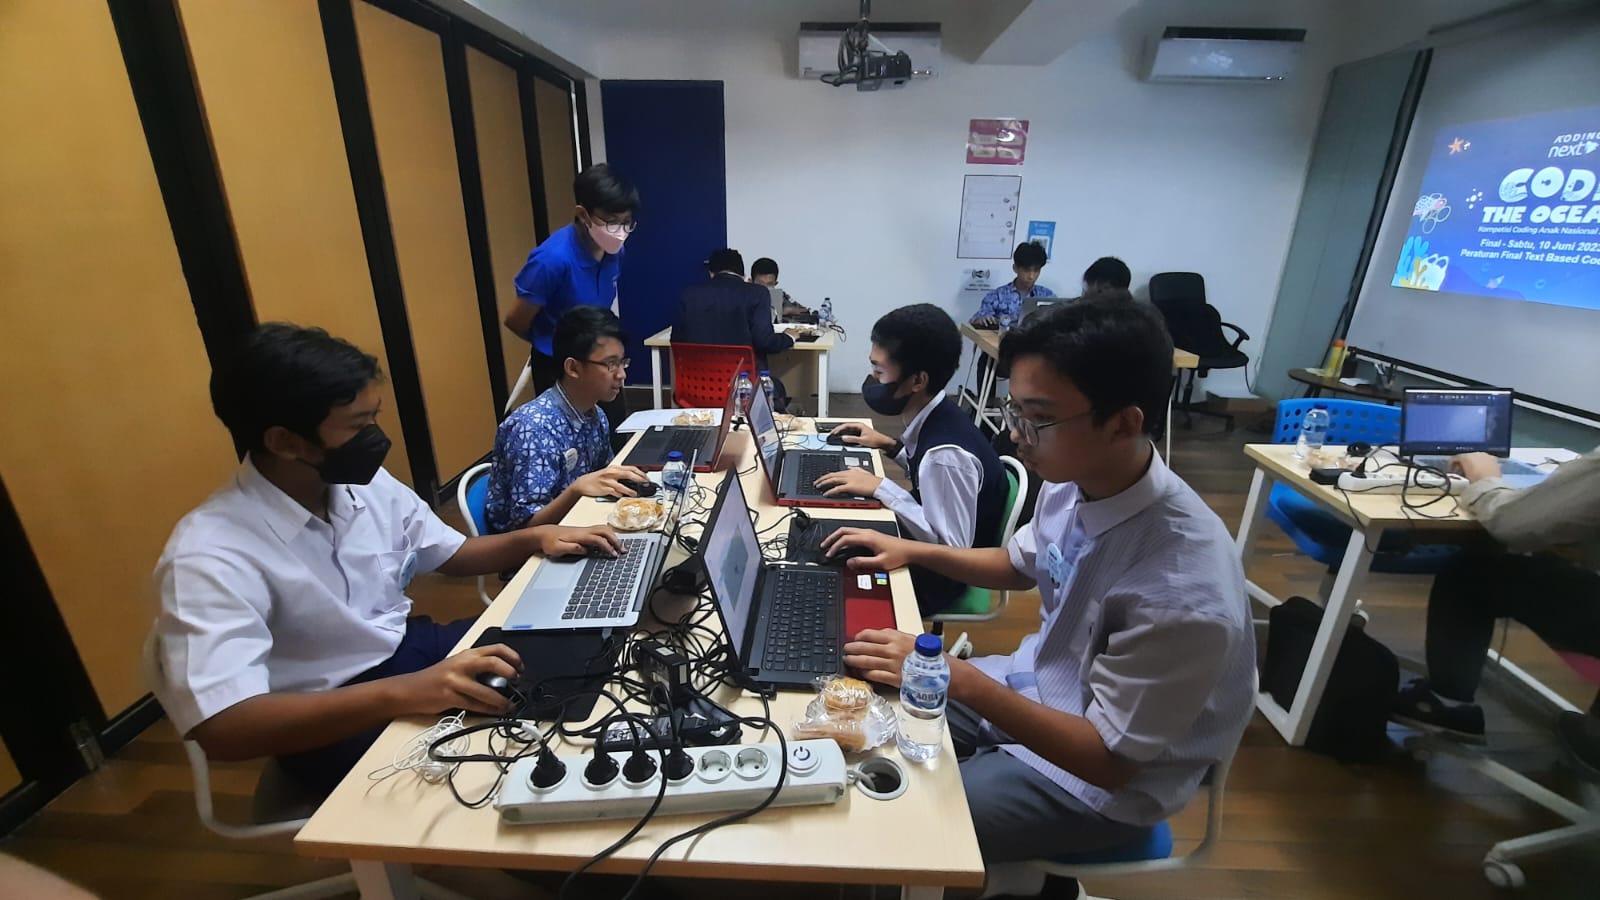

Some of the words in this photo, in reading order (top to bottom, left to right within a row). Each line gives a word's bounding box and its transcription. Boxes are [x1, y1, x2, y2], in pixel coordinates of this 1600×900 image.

[1547, 141, 1584, 158] next
[1482, 206, 1527, 223] THE
[1512, 226, 1538, 235] Coding
[1560, 227, 1599, 235] Nasional
[1480, 239, 1502, 248] Final
[1507, 240, 1535, 250] Sabtu,
[1539, 241, 1551, 250] 10
[1551, 241, 1577, 251] Juni
[1460, 248, 1500, 259] Peraturan
[1500, 250, 1523, 260] Final
[1525, 252, 1545, 261] Text
[1545, 253, 1580, 264] Based
